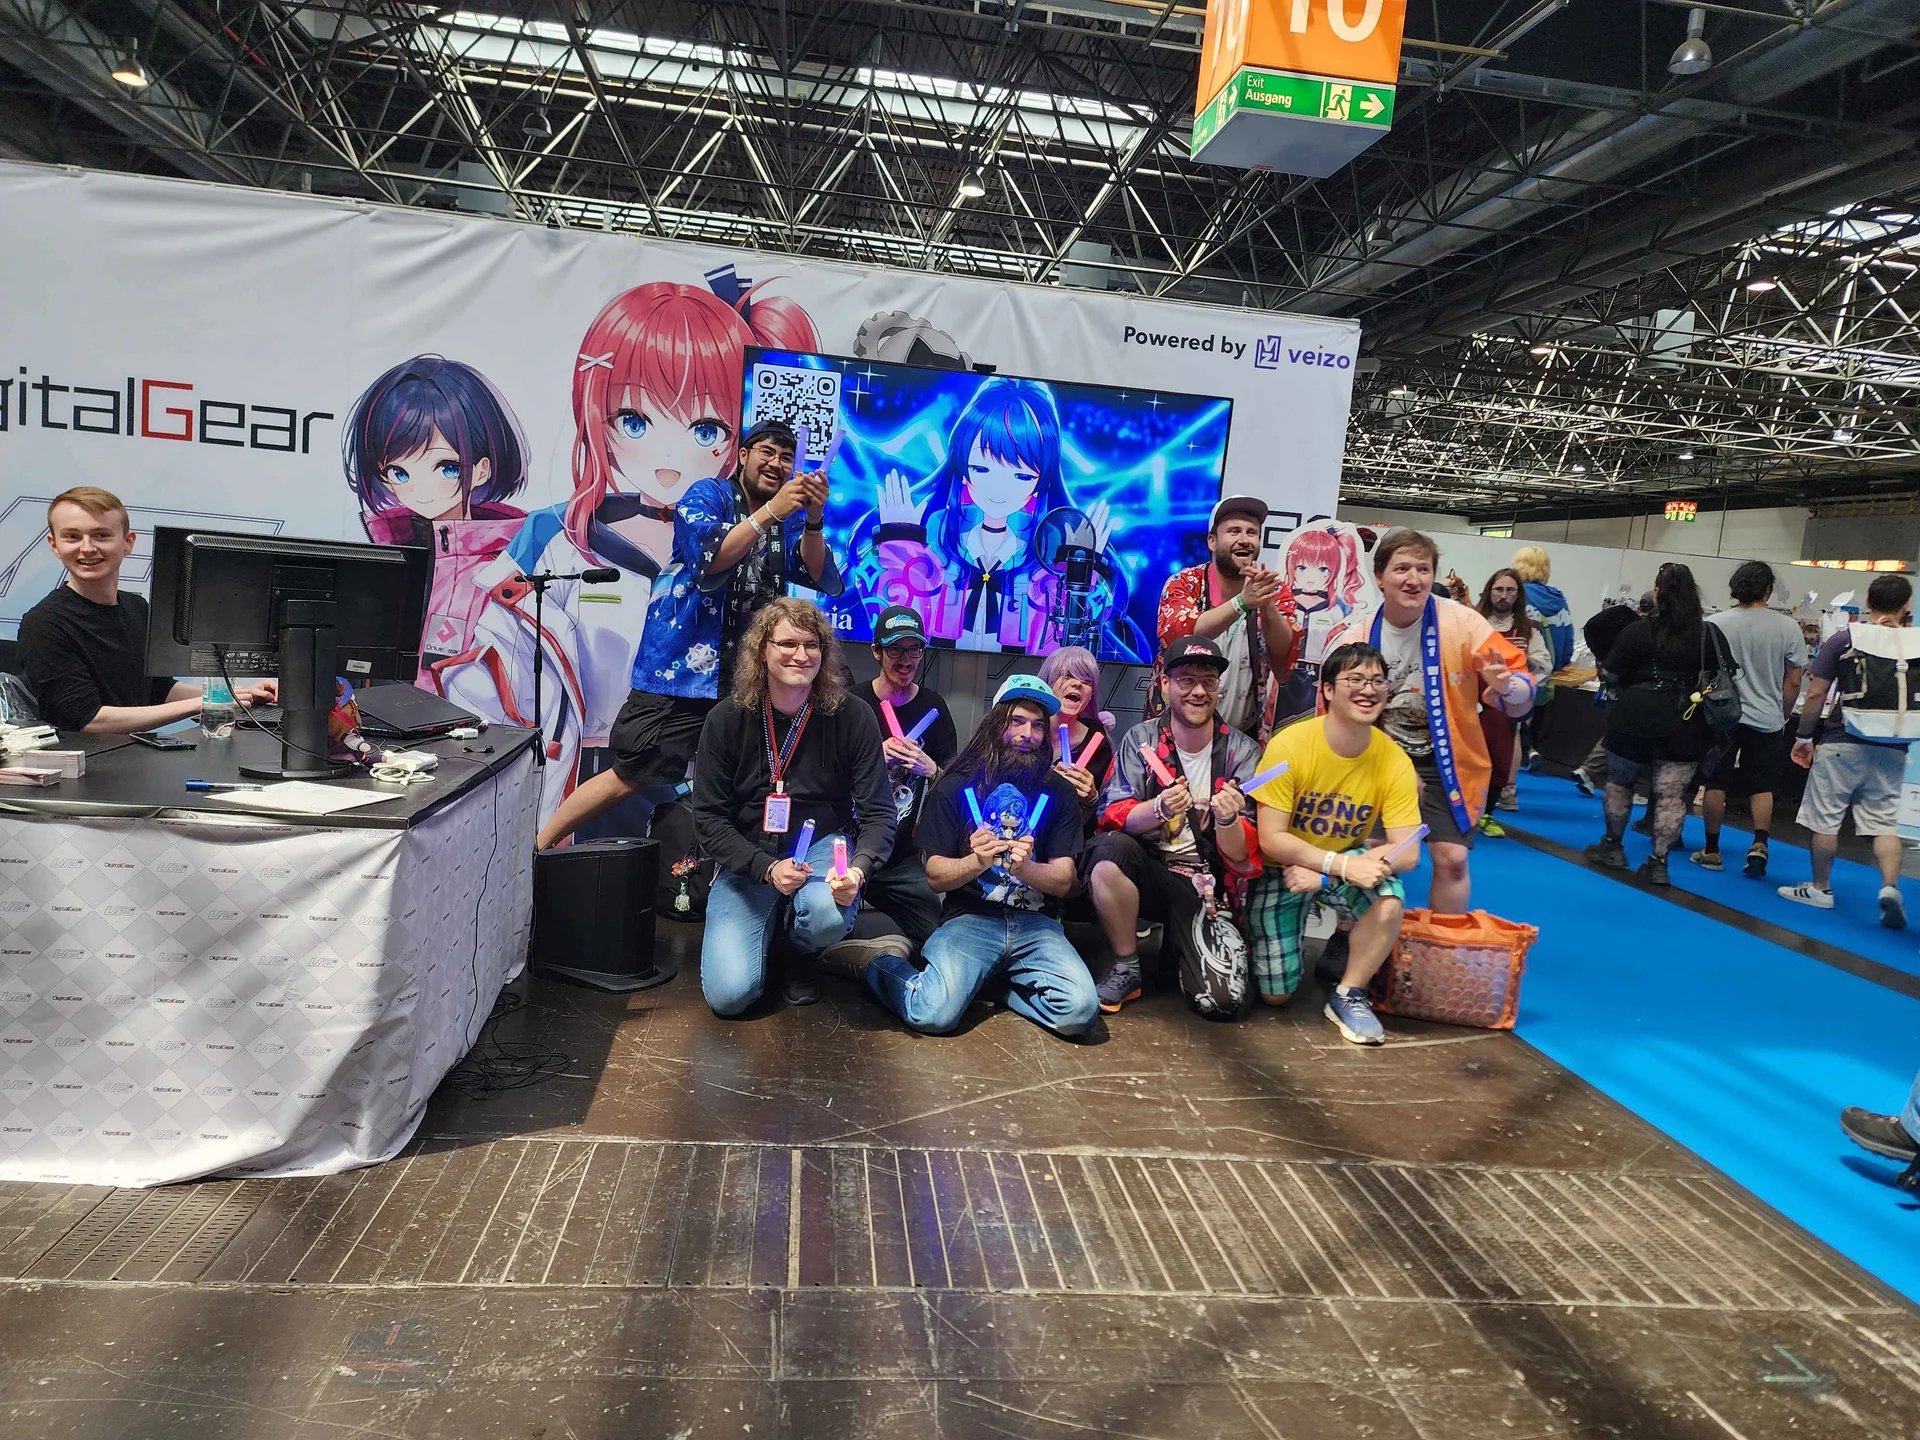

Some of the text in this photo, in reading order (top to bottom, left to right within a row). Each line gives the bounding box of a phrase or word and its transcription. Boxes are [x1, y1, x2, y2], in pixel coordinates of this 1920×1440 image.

[1247, 75, 1265, 89] Exit
[1245, 88, 1292, 108] Ausgang
[1123, 325, 1215, 353] Powered
[1221, 335, 1247, 360] by
[1288, 344, 1351, 370] veizo
[0, 366, 334, 454] italGear
[1426, 625, 1437, 657] Auf
[1296, 796, 1374, 822] HONG
[1292, 813, 1368, 839] KONG
